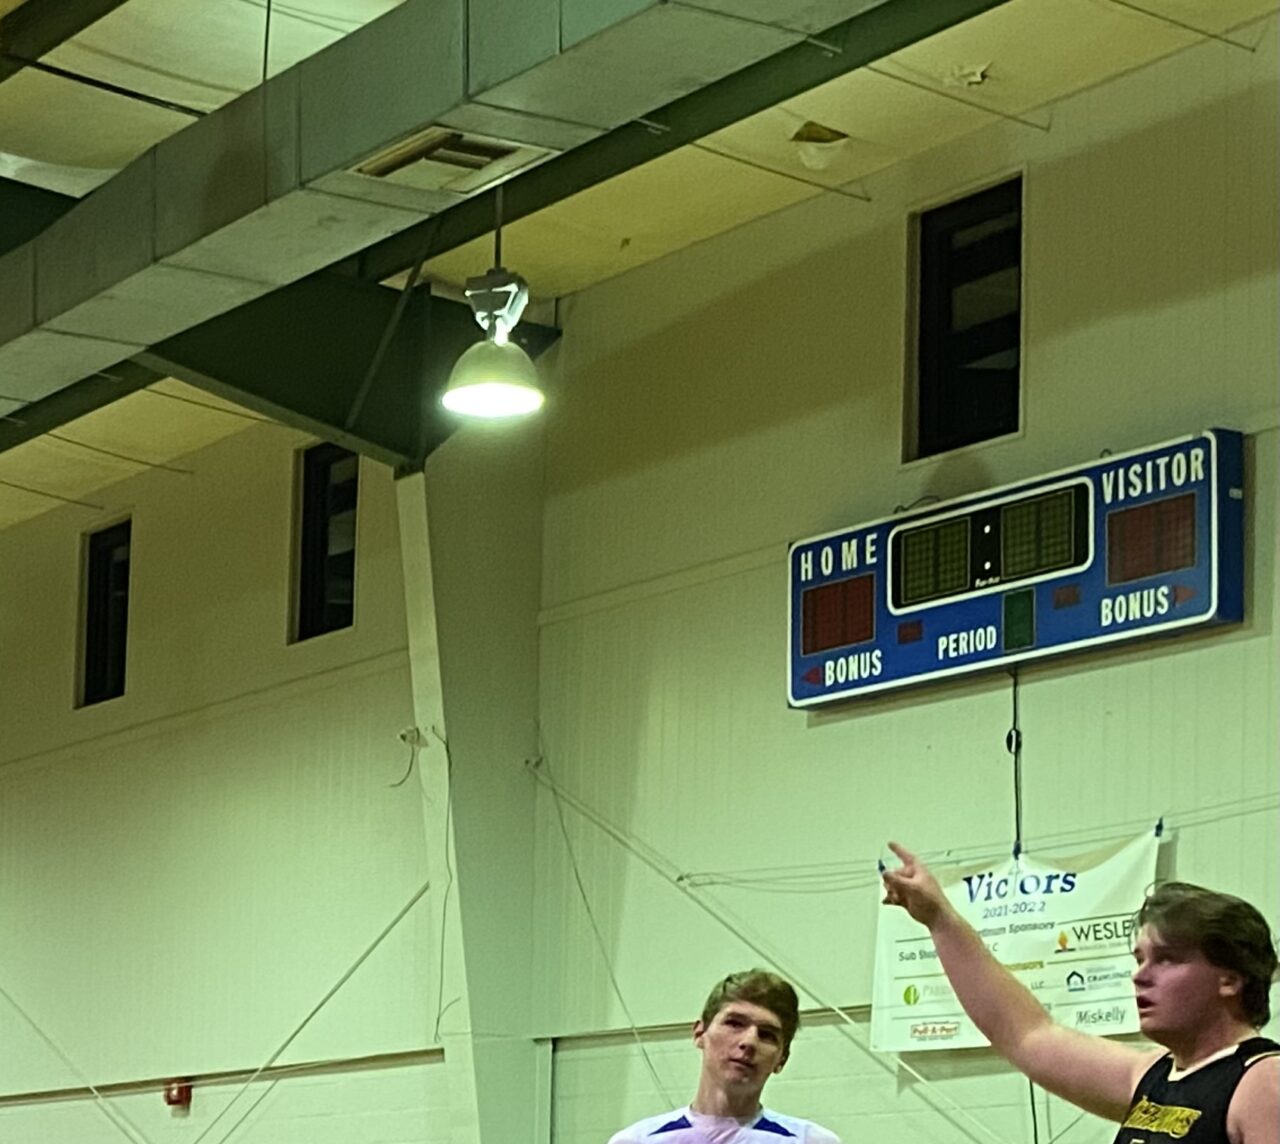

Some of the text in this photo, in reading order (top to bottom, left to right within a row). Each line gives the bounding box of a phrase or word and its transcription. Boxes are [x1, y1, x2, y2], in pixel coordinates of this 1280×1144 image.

[1101, 447, 1205, 505] VISITOR
[800, 533, 879, 582] HOME
[1099, 586, 1170, 627] BONUS
[937, 625, 998, 660] PERIOD
[824, 649, 883, 687] BONUS
[1072, 919, 1132, 941] WESLE
